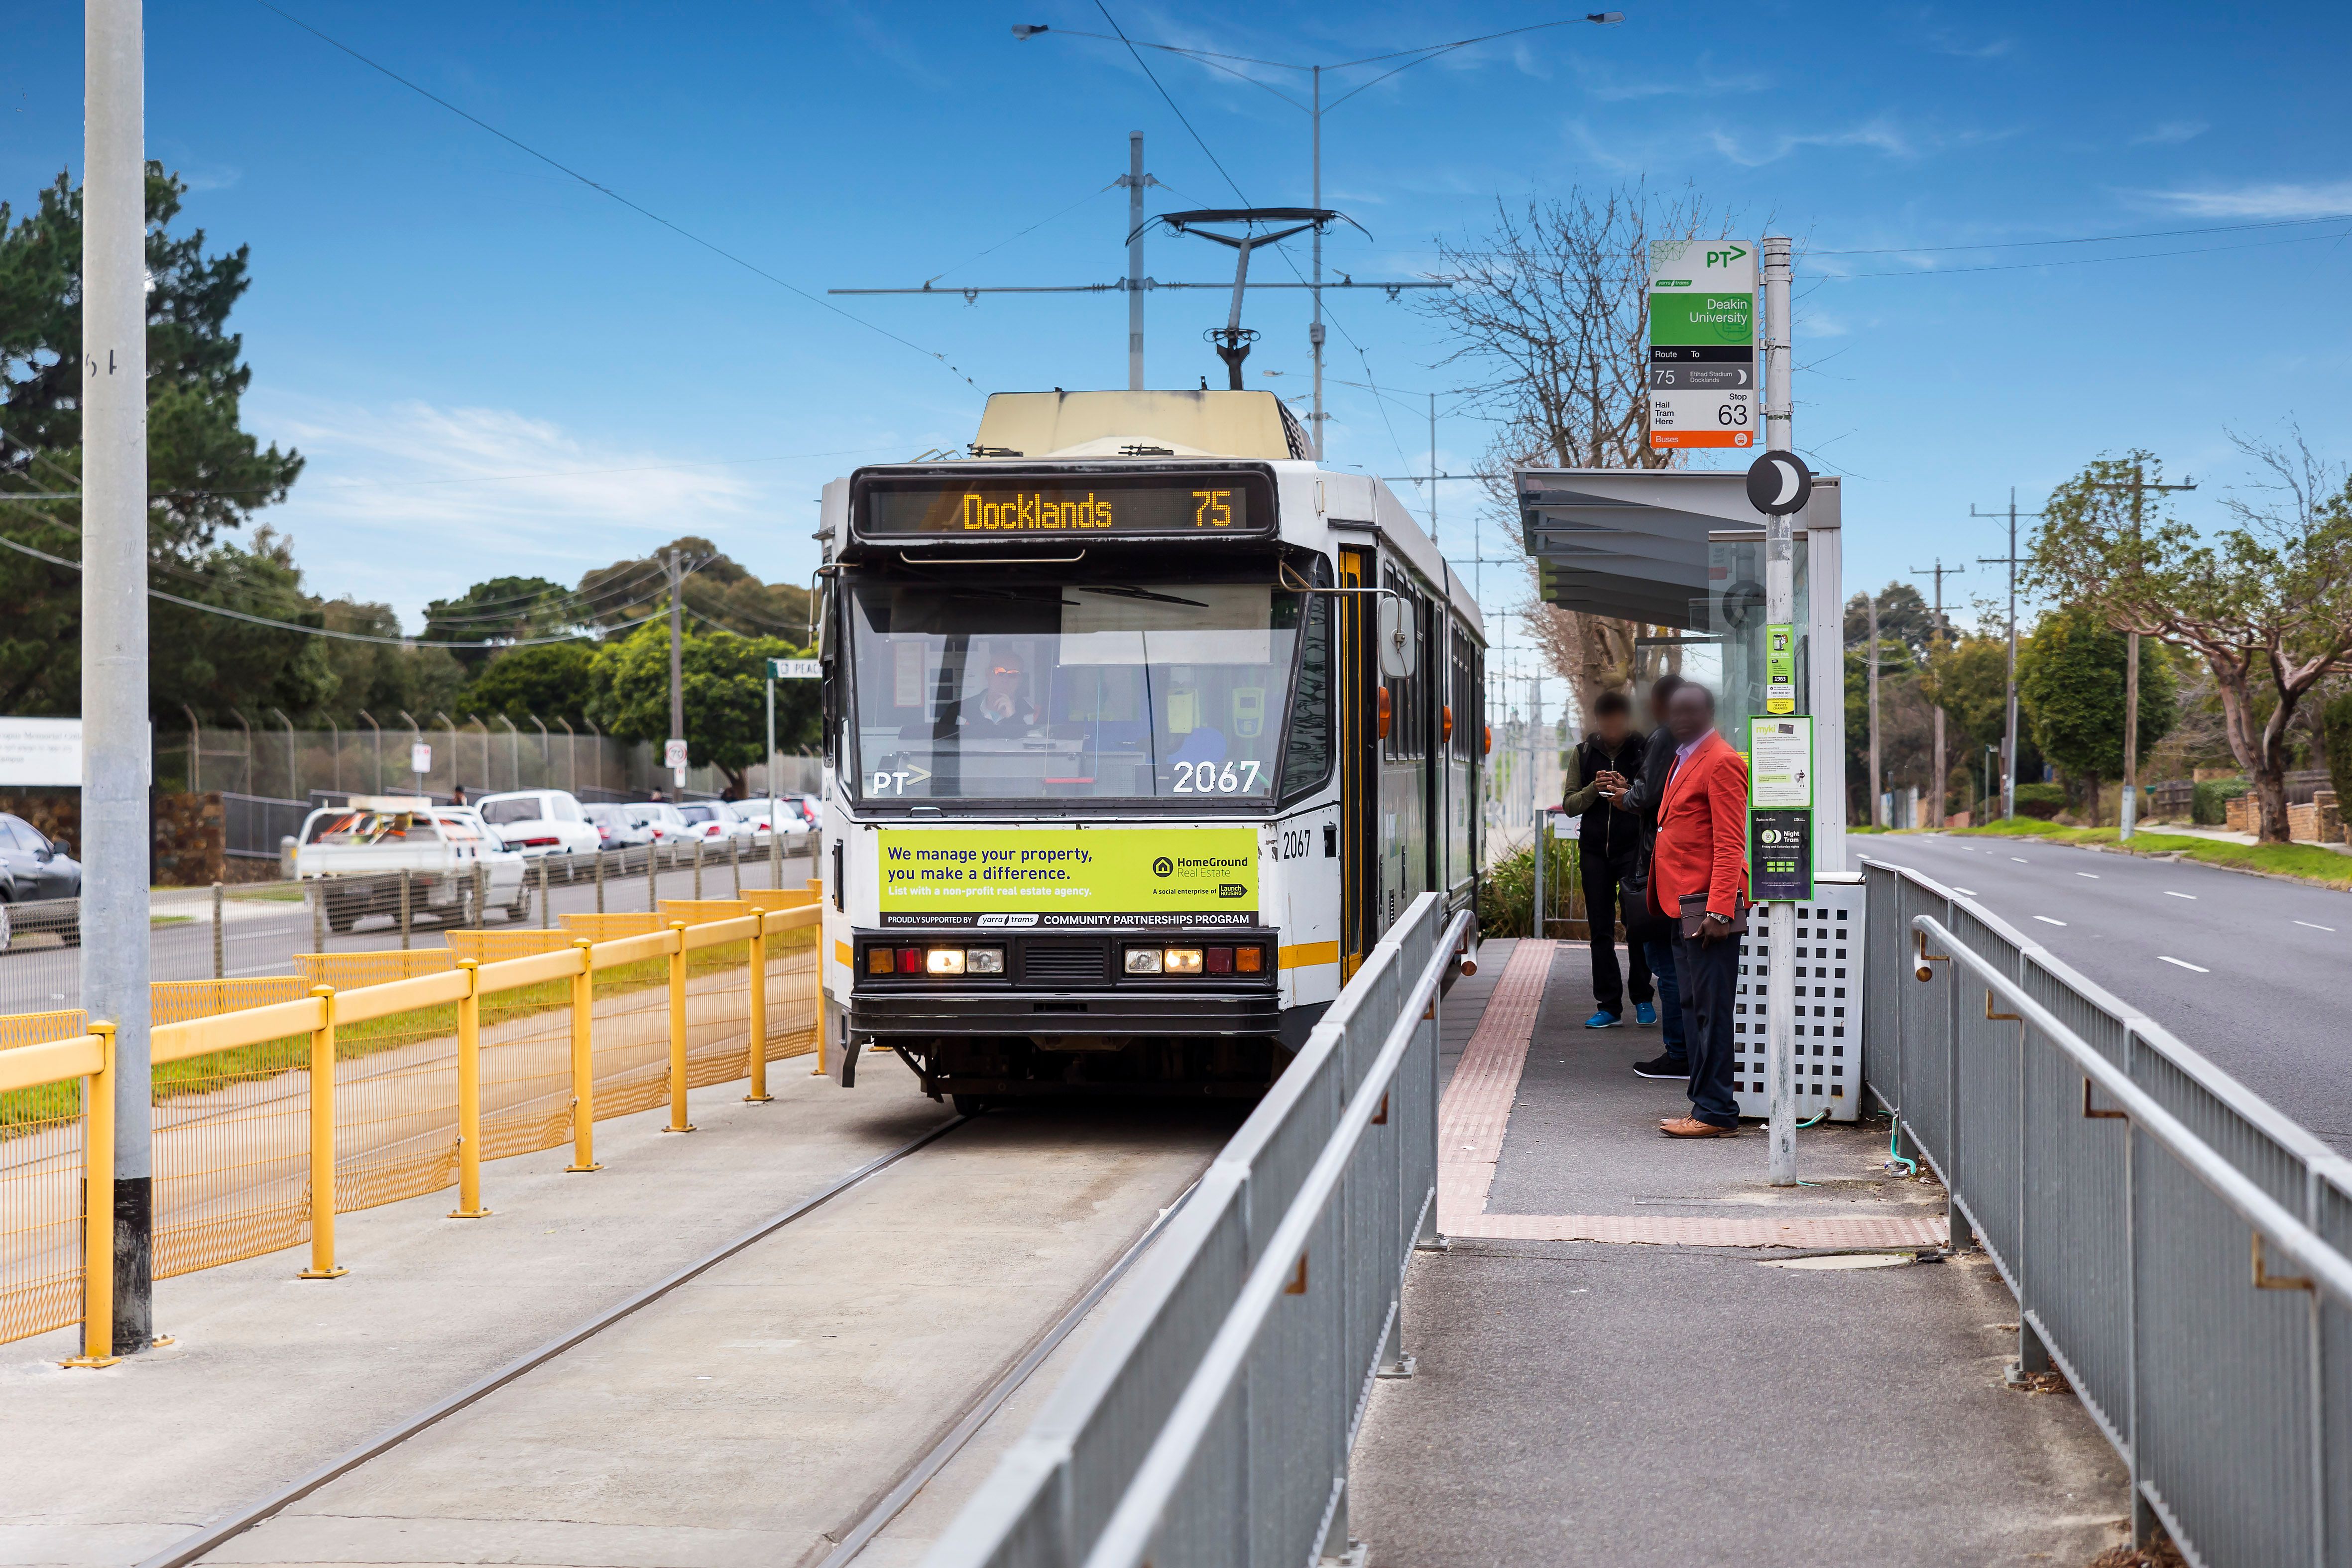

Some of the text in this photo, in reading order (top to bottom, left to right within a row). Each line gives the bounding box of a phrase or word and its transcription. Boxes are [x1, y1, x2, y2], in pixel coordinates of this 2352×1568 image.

[1707, 299, 1747, 309] Deakin
[1689, 312, 1747, 325] University
[1655, 370, 1675, 384] 75
[1718, 404, 1748, 425] 63
[963, 490, 1230, 530] Docklands 75
[1756, 724, 1775, 735] myki
[1173, 760, 1261, 793] 2067
[1283, 829, 1310, 859] 2067
[888, 846, 1092, 864] We manage your property,
[1177, 857, 1248, 867] HomeGround
[888, 866, 1071, 883] you make a difference.
[1177, 868, 1231, 877] Real Estate
[888, 886, 908, 896] List
[909, 886, 932, 896] with
[942, 886, 994, 898] non-profit
[997, 886, 1018, 896] real
[1020, 886, 1052, 896] estate
[1054, 888, 1092, 897] agency.
[1011, 915, 1034, 924] trams
[1044, 915, 1110, 925] COMMUNITY
[1113, 915, 1193, 925] PARTNERSHIPS
[1195, 915, 1249, 924] PROGRAM
